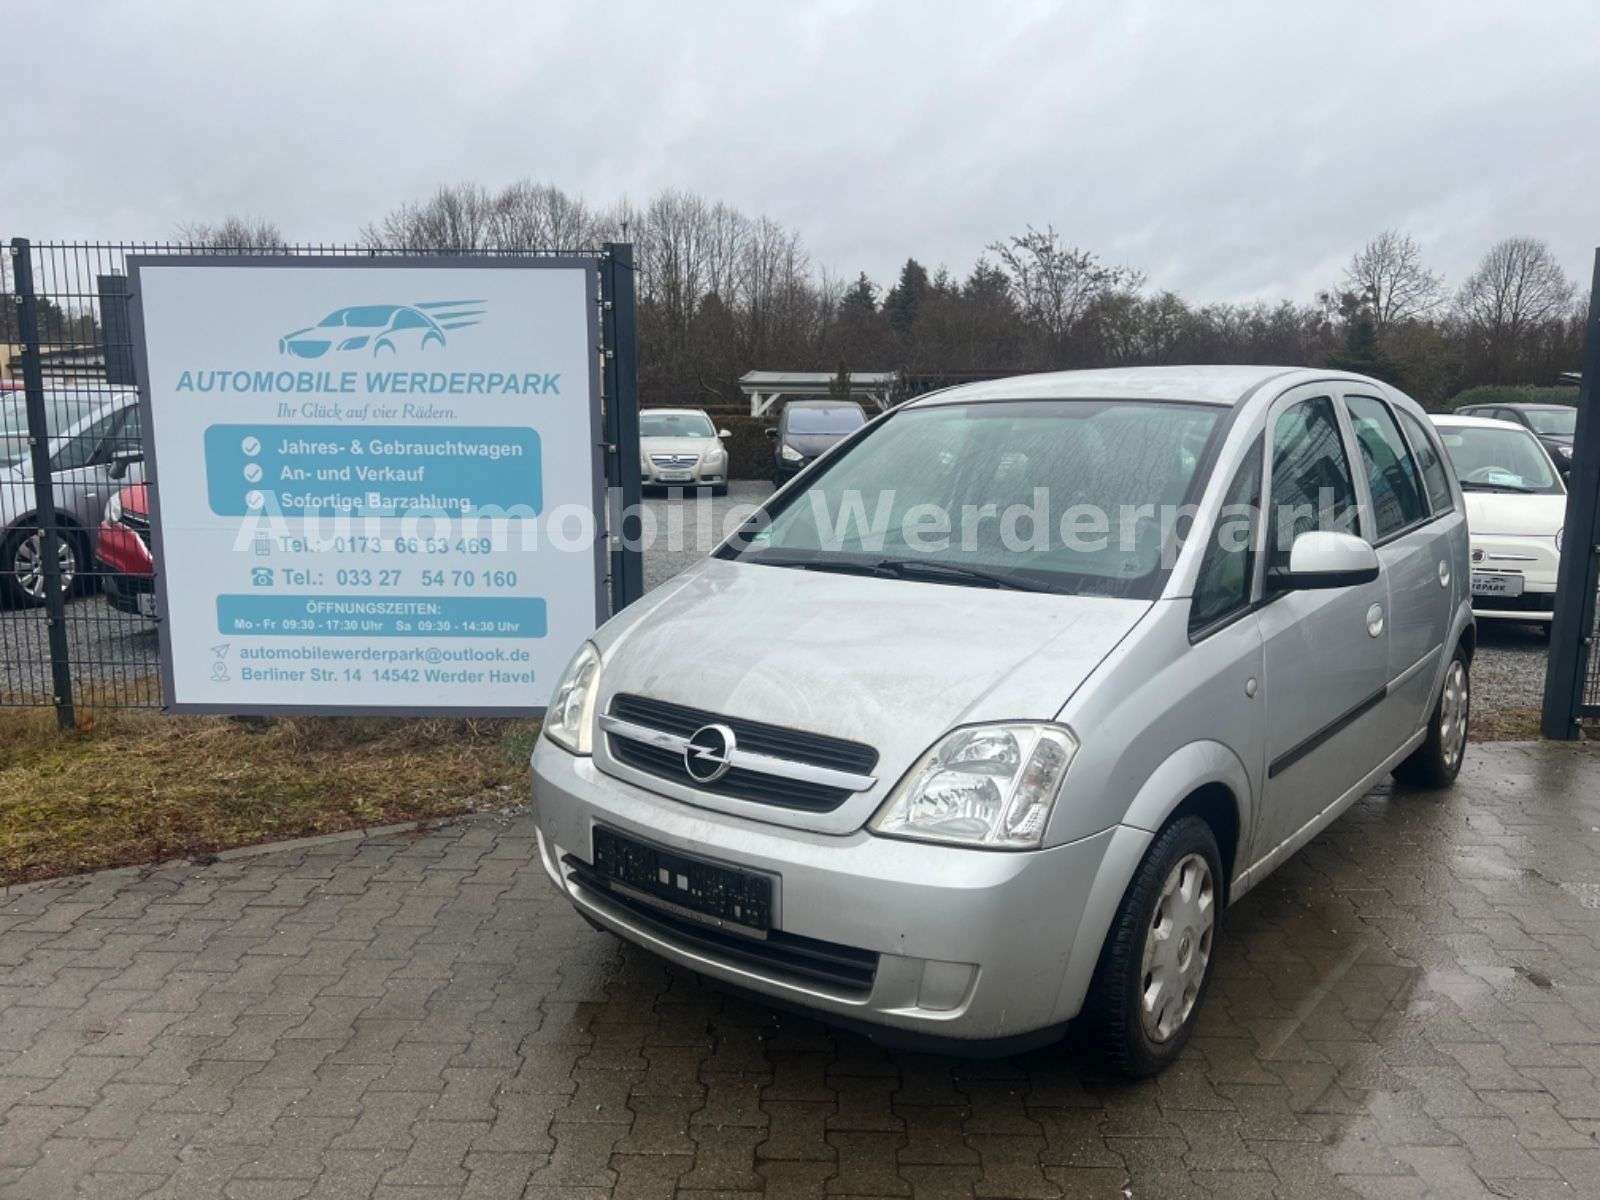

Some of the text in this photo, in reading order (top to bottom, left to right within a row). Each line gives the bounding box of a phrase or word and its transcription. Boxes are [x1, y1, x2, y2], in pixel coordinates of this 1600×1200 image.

[176, 370, 561, 395] AUTOMOBILE WERDERPARK
[277, 402, 458, 421] Ihr Glück auf vier Rädern.
[278, 440, 523, 459] Jahres- & Gebrauchtwagen
[280, 466, 425, 482] An- und Verkauf
[281, 493, 472, 512] Sofortige Barzahlung
[335, 536, 382, 553] 0173
[455, 538, 492, 554] 469
[282, 569, 517, 587] Tel.: 033 27 54 70 160
[306, 600, 442, 615] ÖFFNUNGSZEITEN:
[234, 619, 253, 629] Mo
[263, 619, 276, 630] Fr
[283, 619, 315, 630] 09:30
[327, 620, 358, 630] 17:30
[361, 620, 383, 631] Uhr
[396, 620, 411, 631] Sa
[418, 621, 450, 631] 09:30
[498, 622, 520, 632] Uhr
[240, 646, 530, 664] automobilewerderpark@outlook.de
[241, 668, 535, 683] Berliner Str. 14 14542 Werder Havel
